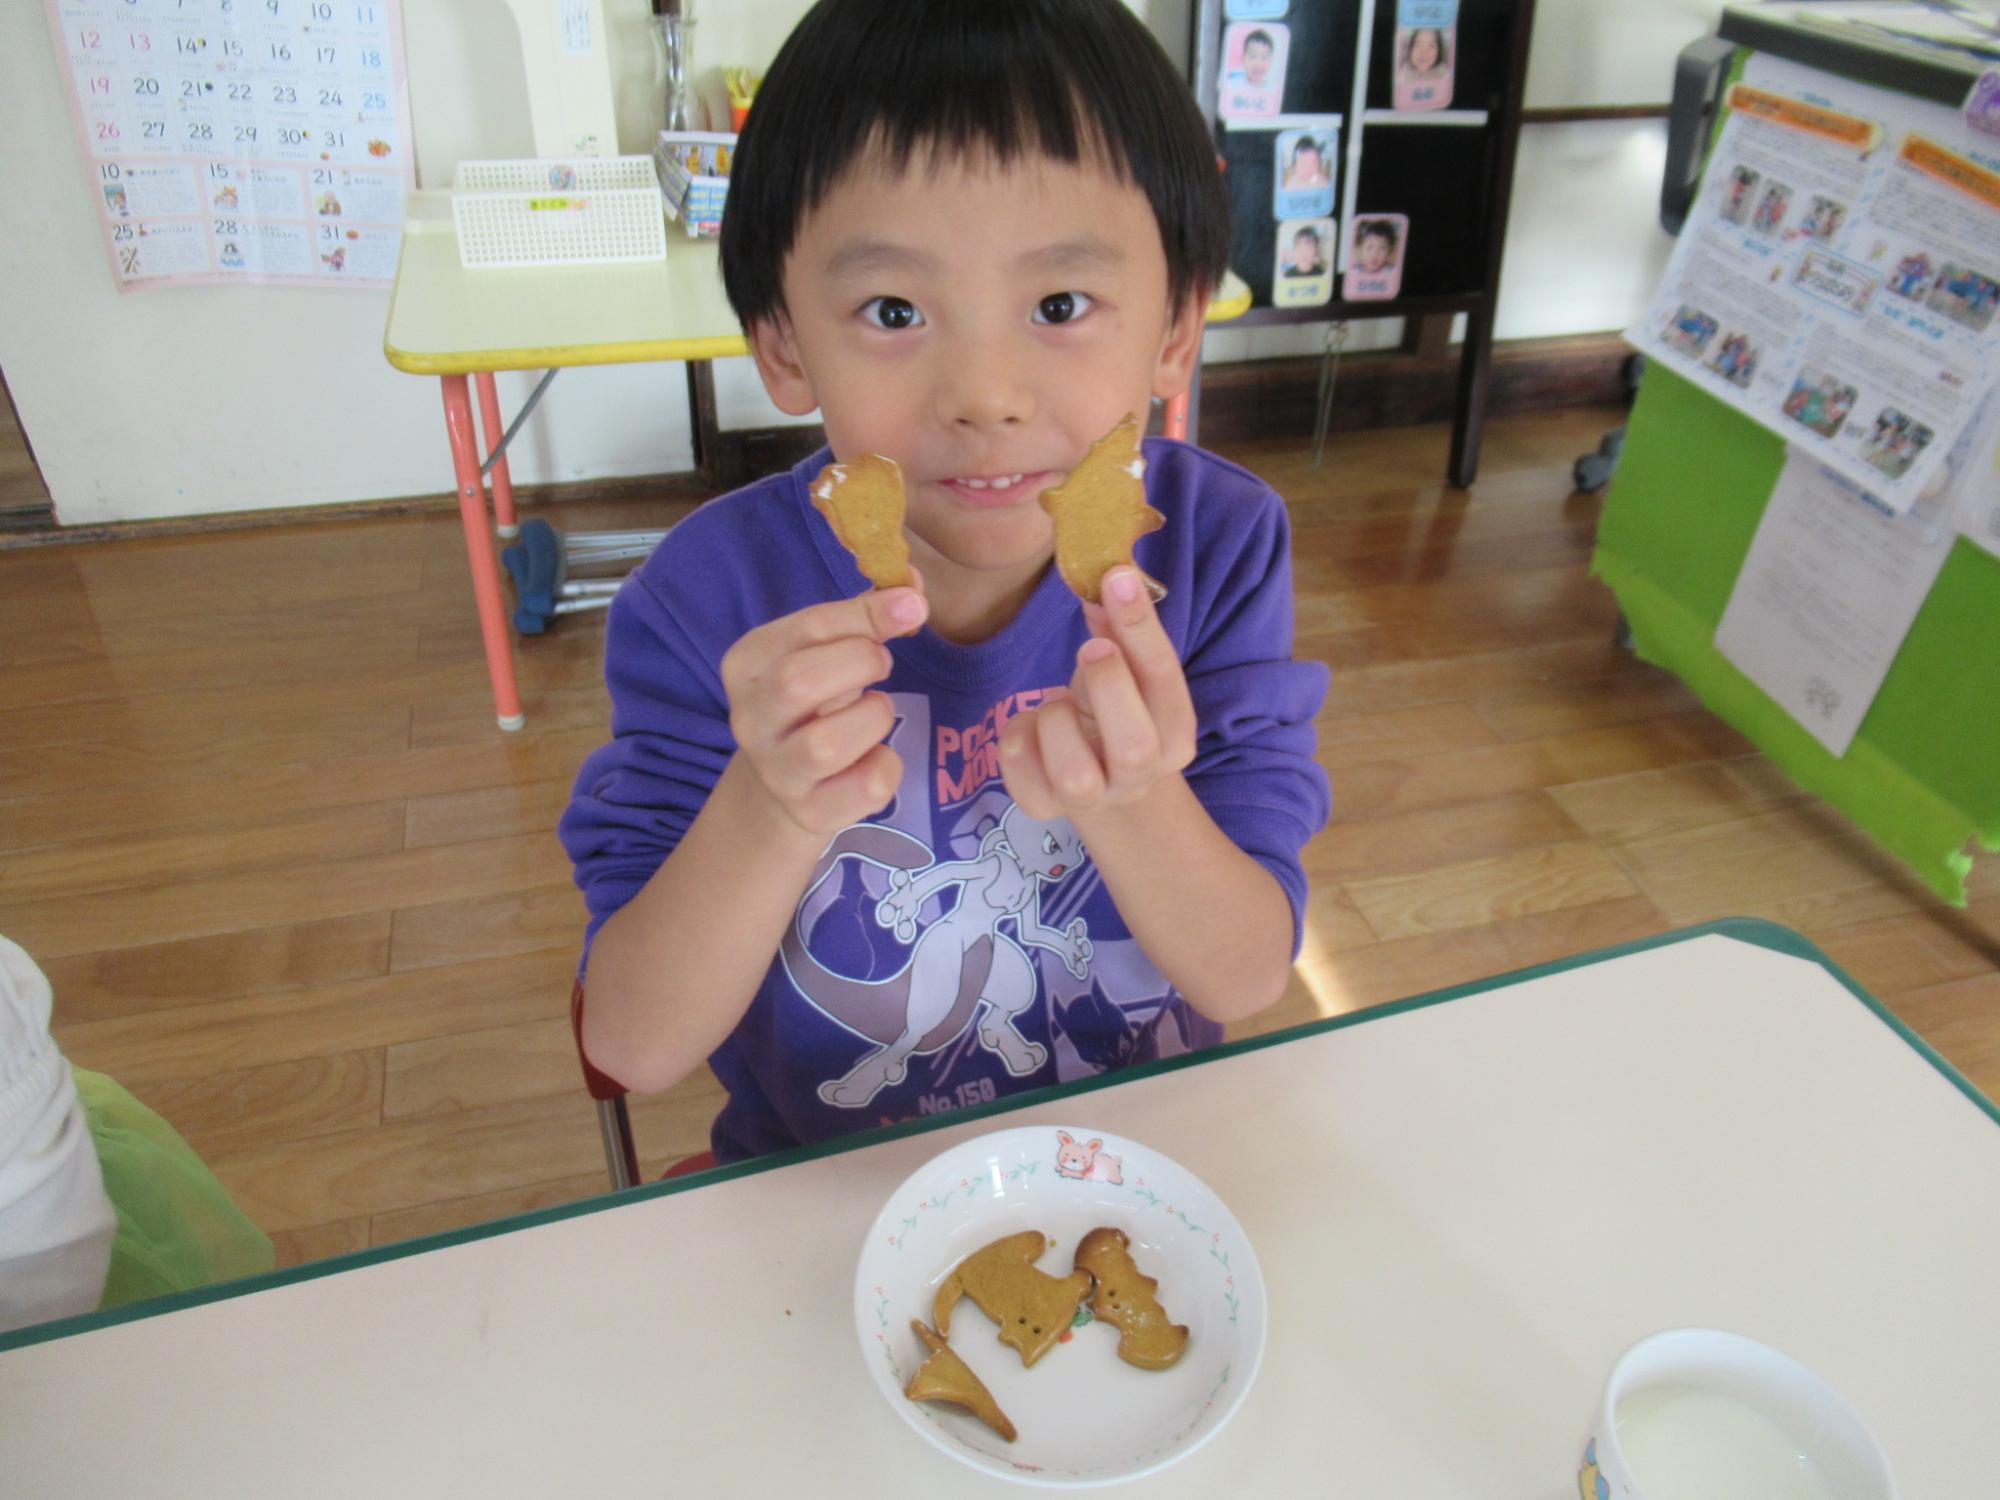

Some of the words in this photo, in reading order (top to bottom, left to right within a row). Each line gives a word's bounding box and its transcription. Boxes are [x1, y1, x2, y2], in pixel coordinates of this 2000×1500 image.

[266, 0, 279, 16] 9
[312, 3, 332, 20] 10
[357, 5, 374, 23] 11
[81, 31, 101, 49] 12
[130, 32, 151, 50] 13
[177, 36, 197, 54] 14
[223, 39, 243, 57] 15
[271, 44, 291, 60] 16
[317, 47, 336, 63] 17
[362, 50, 382, 67] 18
[90, 76, 110, 94] 19
[134, 77, 159, 95] 20
[182, 80, 202, 97] 21
[227, 83, 251, 101] 22
[273, 85, 297, 103] 23
[318, 89, 342, 107] 24
[362, 92, 387, 110] 25
[97, 121, 120, 139] 26
[142, 121, 165, 138] 27
[188, 123, 213, 140] 28
[234, 125, 257, 142] 29
[278, 128, 301, 145] 30
[325, 131, 345, 148] 31
[101, 162, 120, 179] 10
[210, 163, 229, 178] 15
[313, 168, 333, 184] 21
[112, 223, 133, 241] 25
[214, 219, 238, 235] 28
[321, 225, 339, 240] 31
[919, 1077, 997, 1115] No.150
